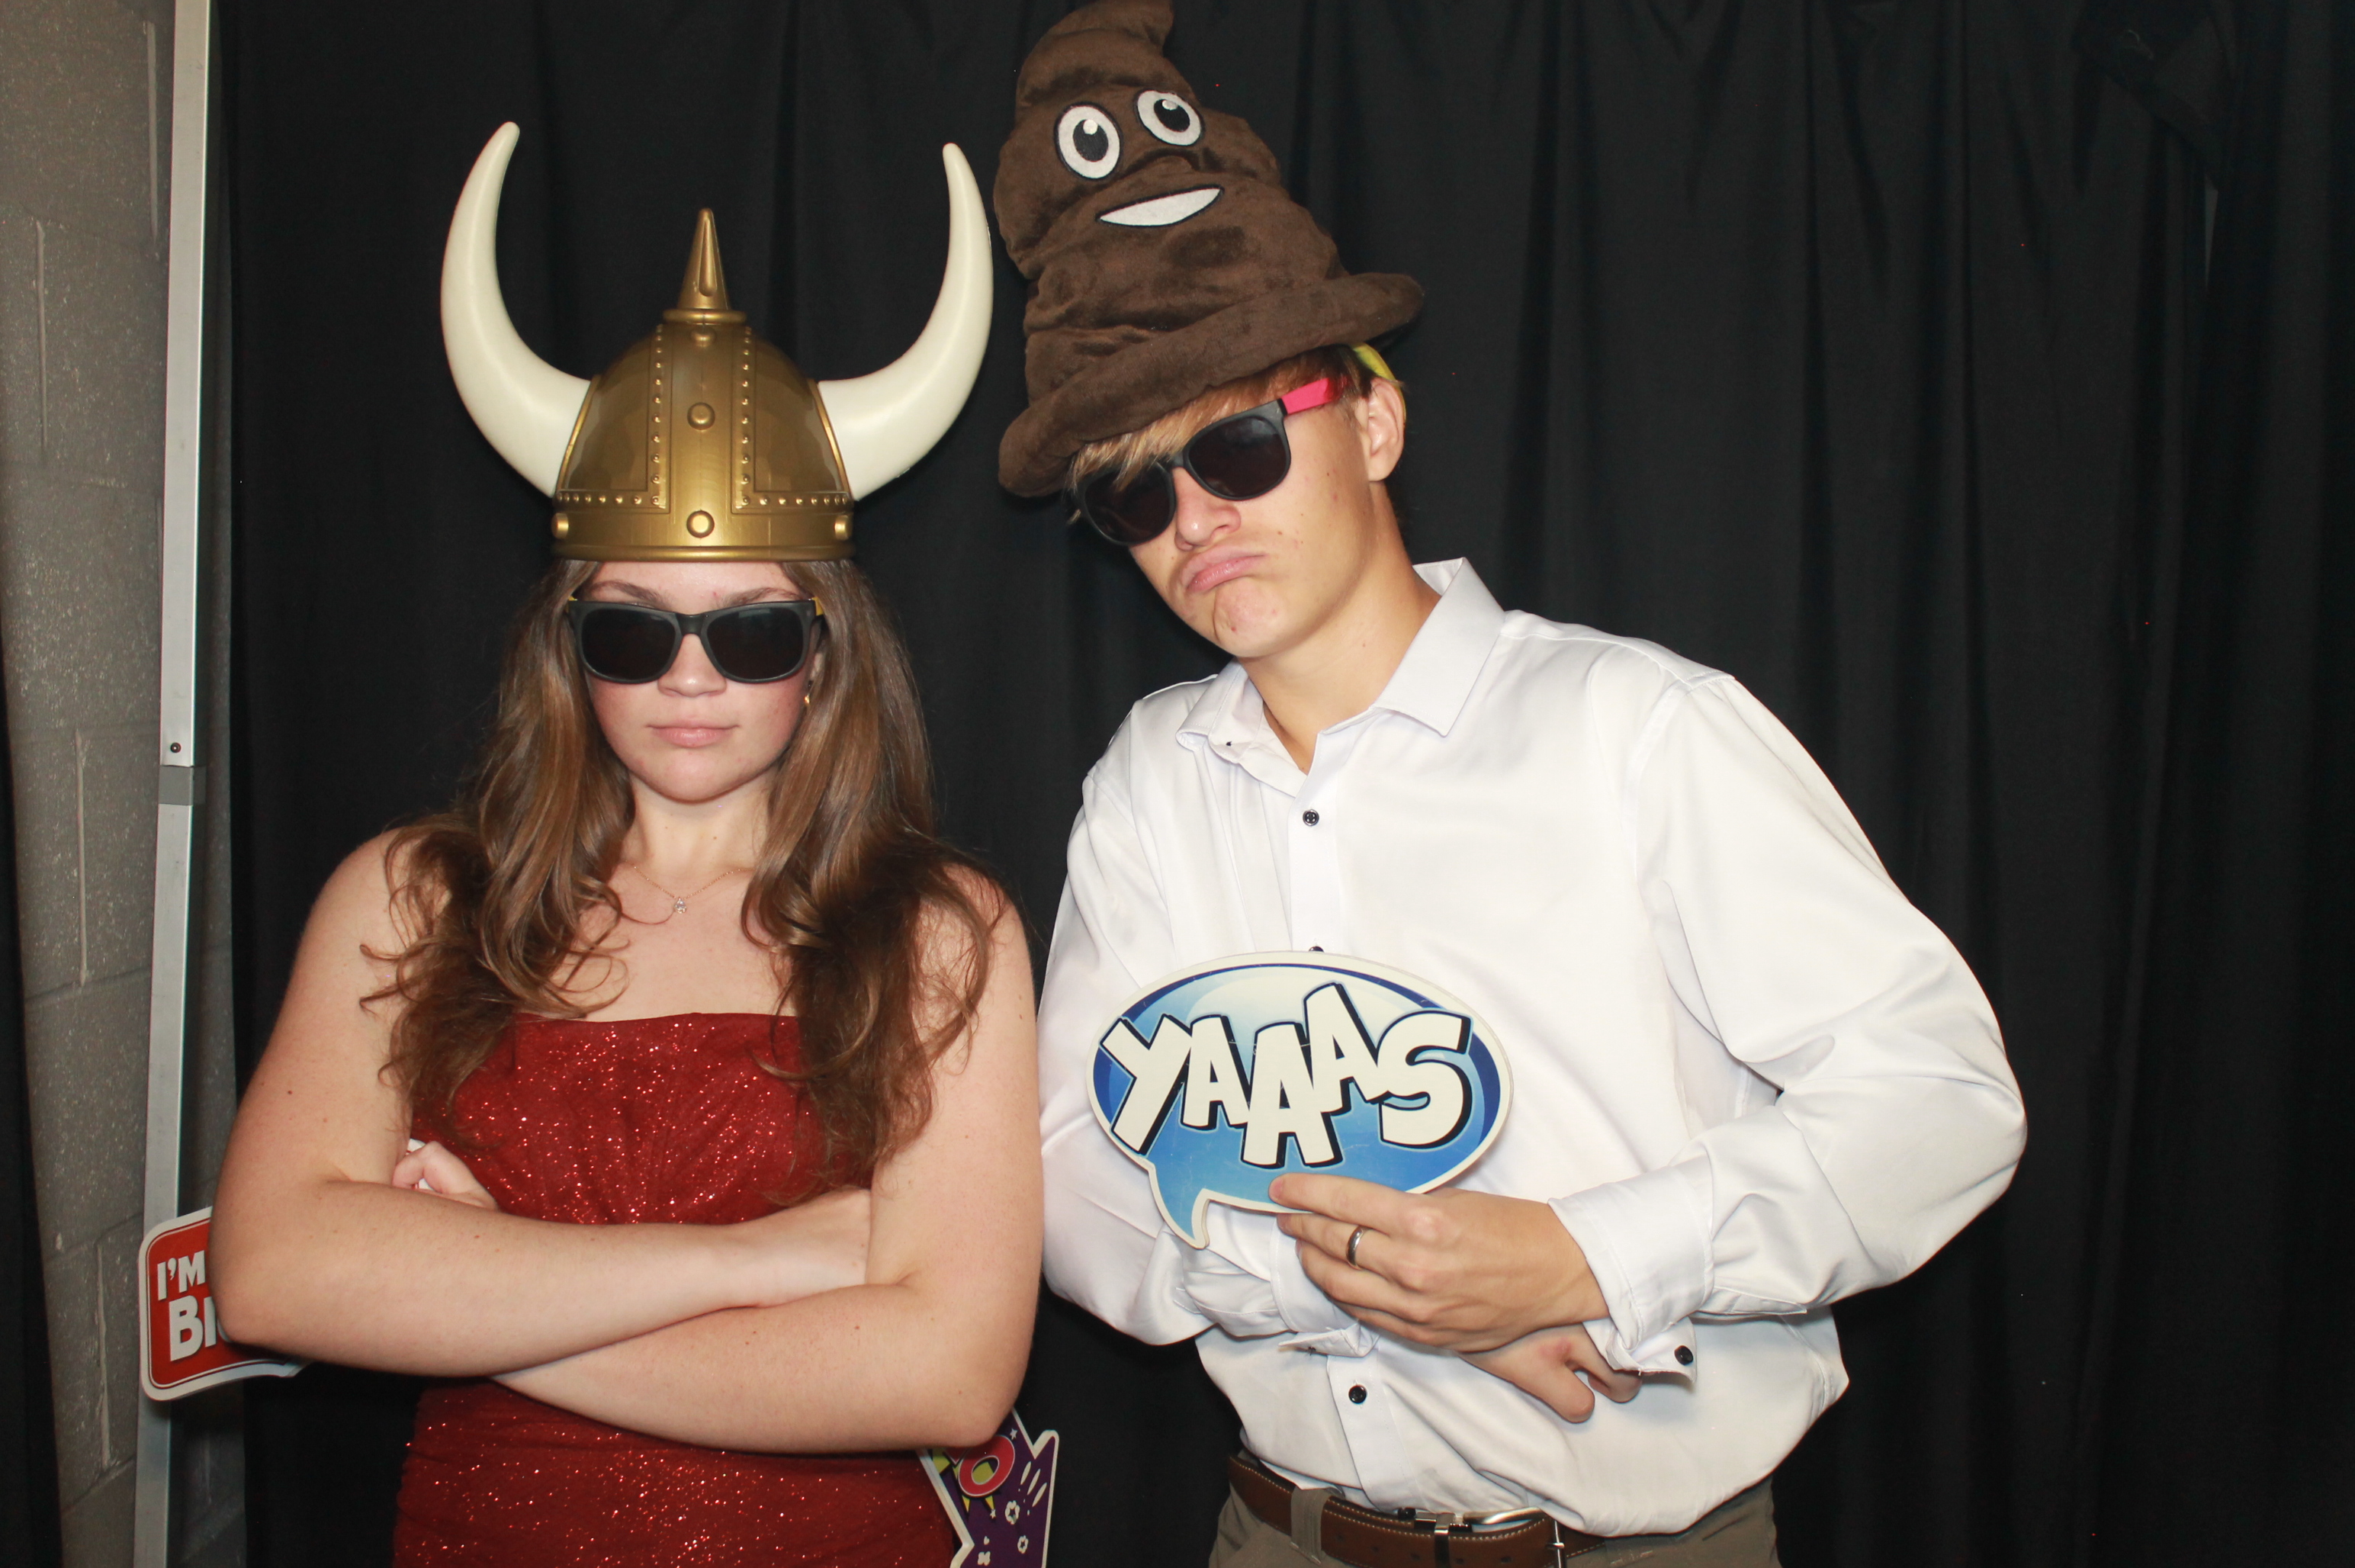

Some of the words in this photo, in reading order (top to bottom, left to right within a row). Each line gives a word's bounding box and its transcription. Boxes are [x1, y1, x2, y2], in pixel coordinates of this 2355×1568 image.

[1100, 982, 1472, 1168] YAAAS
[157, 1250, 206, 1301] I'M
[169, 1295, 230, 1361] BI
